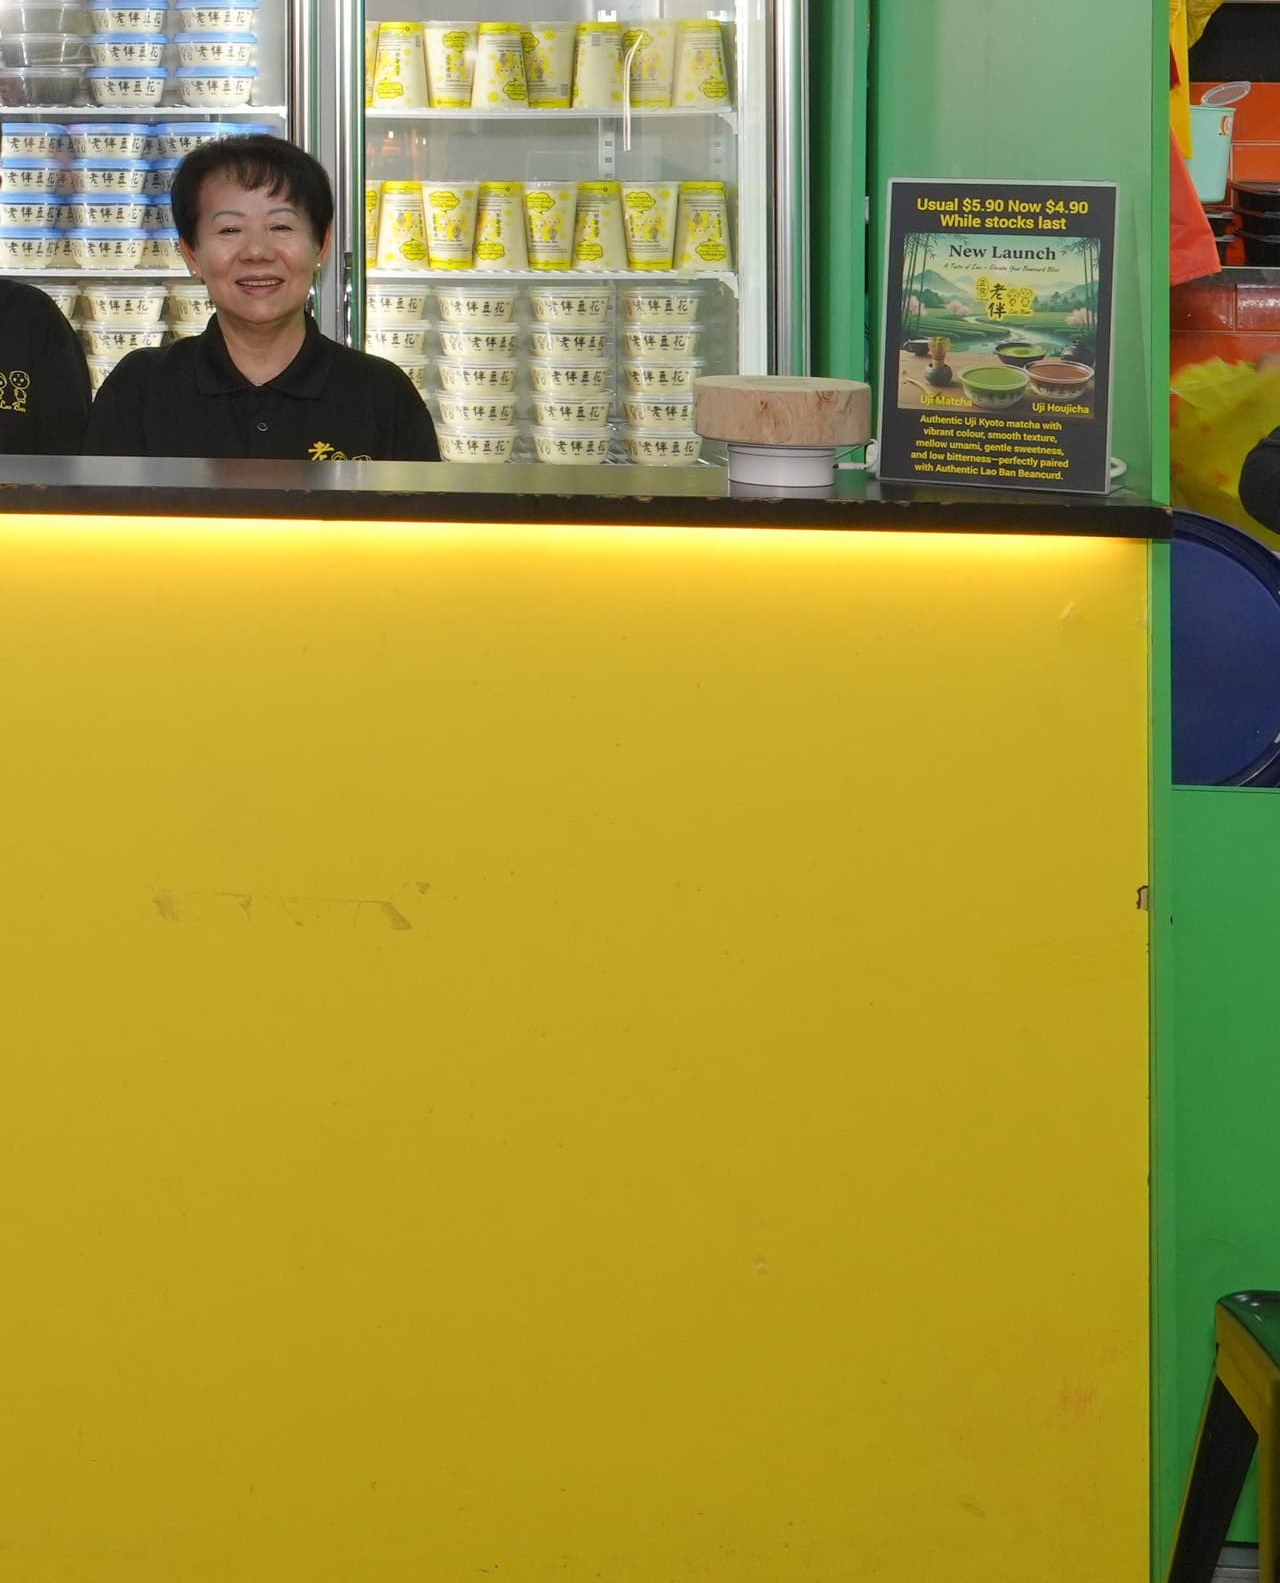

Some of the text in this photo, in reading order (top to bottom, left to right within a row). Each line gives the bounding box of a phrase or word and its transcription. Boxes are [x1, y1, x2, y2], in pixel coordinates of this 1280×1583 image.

[917, 198, 1088, 214] Usual $5.90 Now $4.90
[940, 214, 1066, 230] While stocks last
[949, 245, 1056, 260] New Launch
[988, 283, 1007, 318] 老伴
[920, 395, 972, 407] Uji Matcha
[1032, 403, 1089, 414] Uji Houjicha
[920, 415, 1062, 430] Authentic Uji Kyoto matcha with
[924, 427, 1057, 443] vibrant colour, smooth texture,
[916, 439, 1064, 456] mellow umami, gentle sweetness,
[911, 451, 927, 459] and
[929, 451, 945, 460] low
[1040, 458, 1069, 468] paired
[914, 463, 1063, 480] with Authentic Lao Ban Beancurd.
